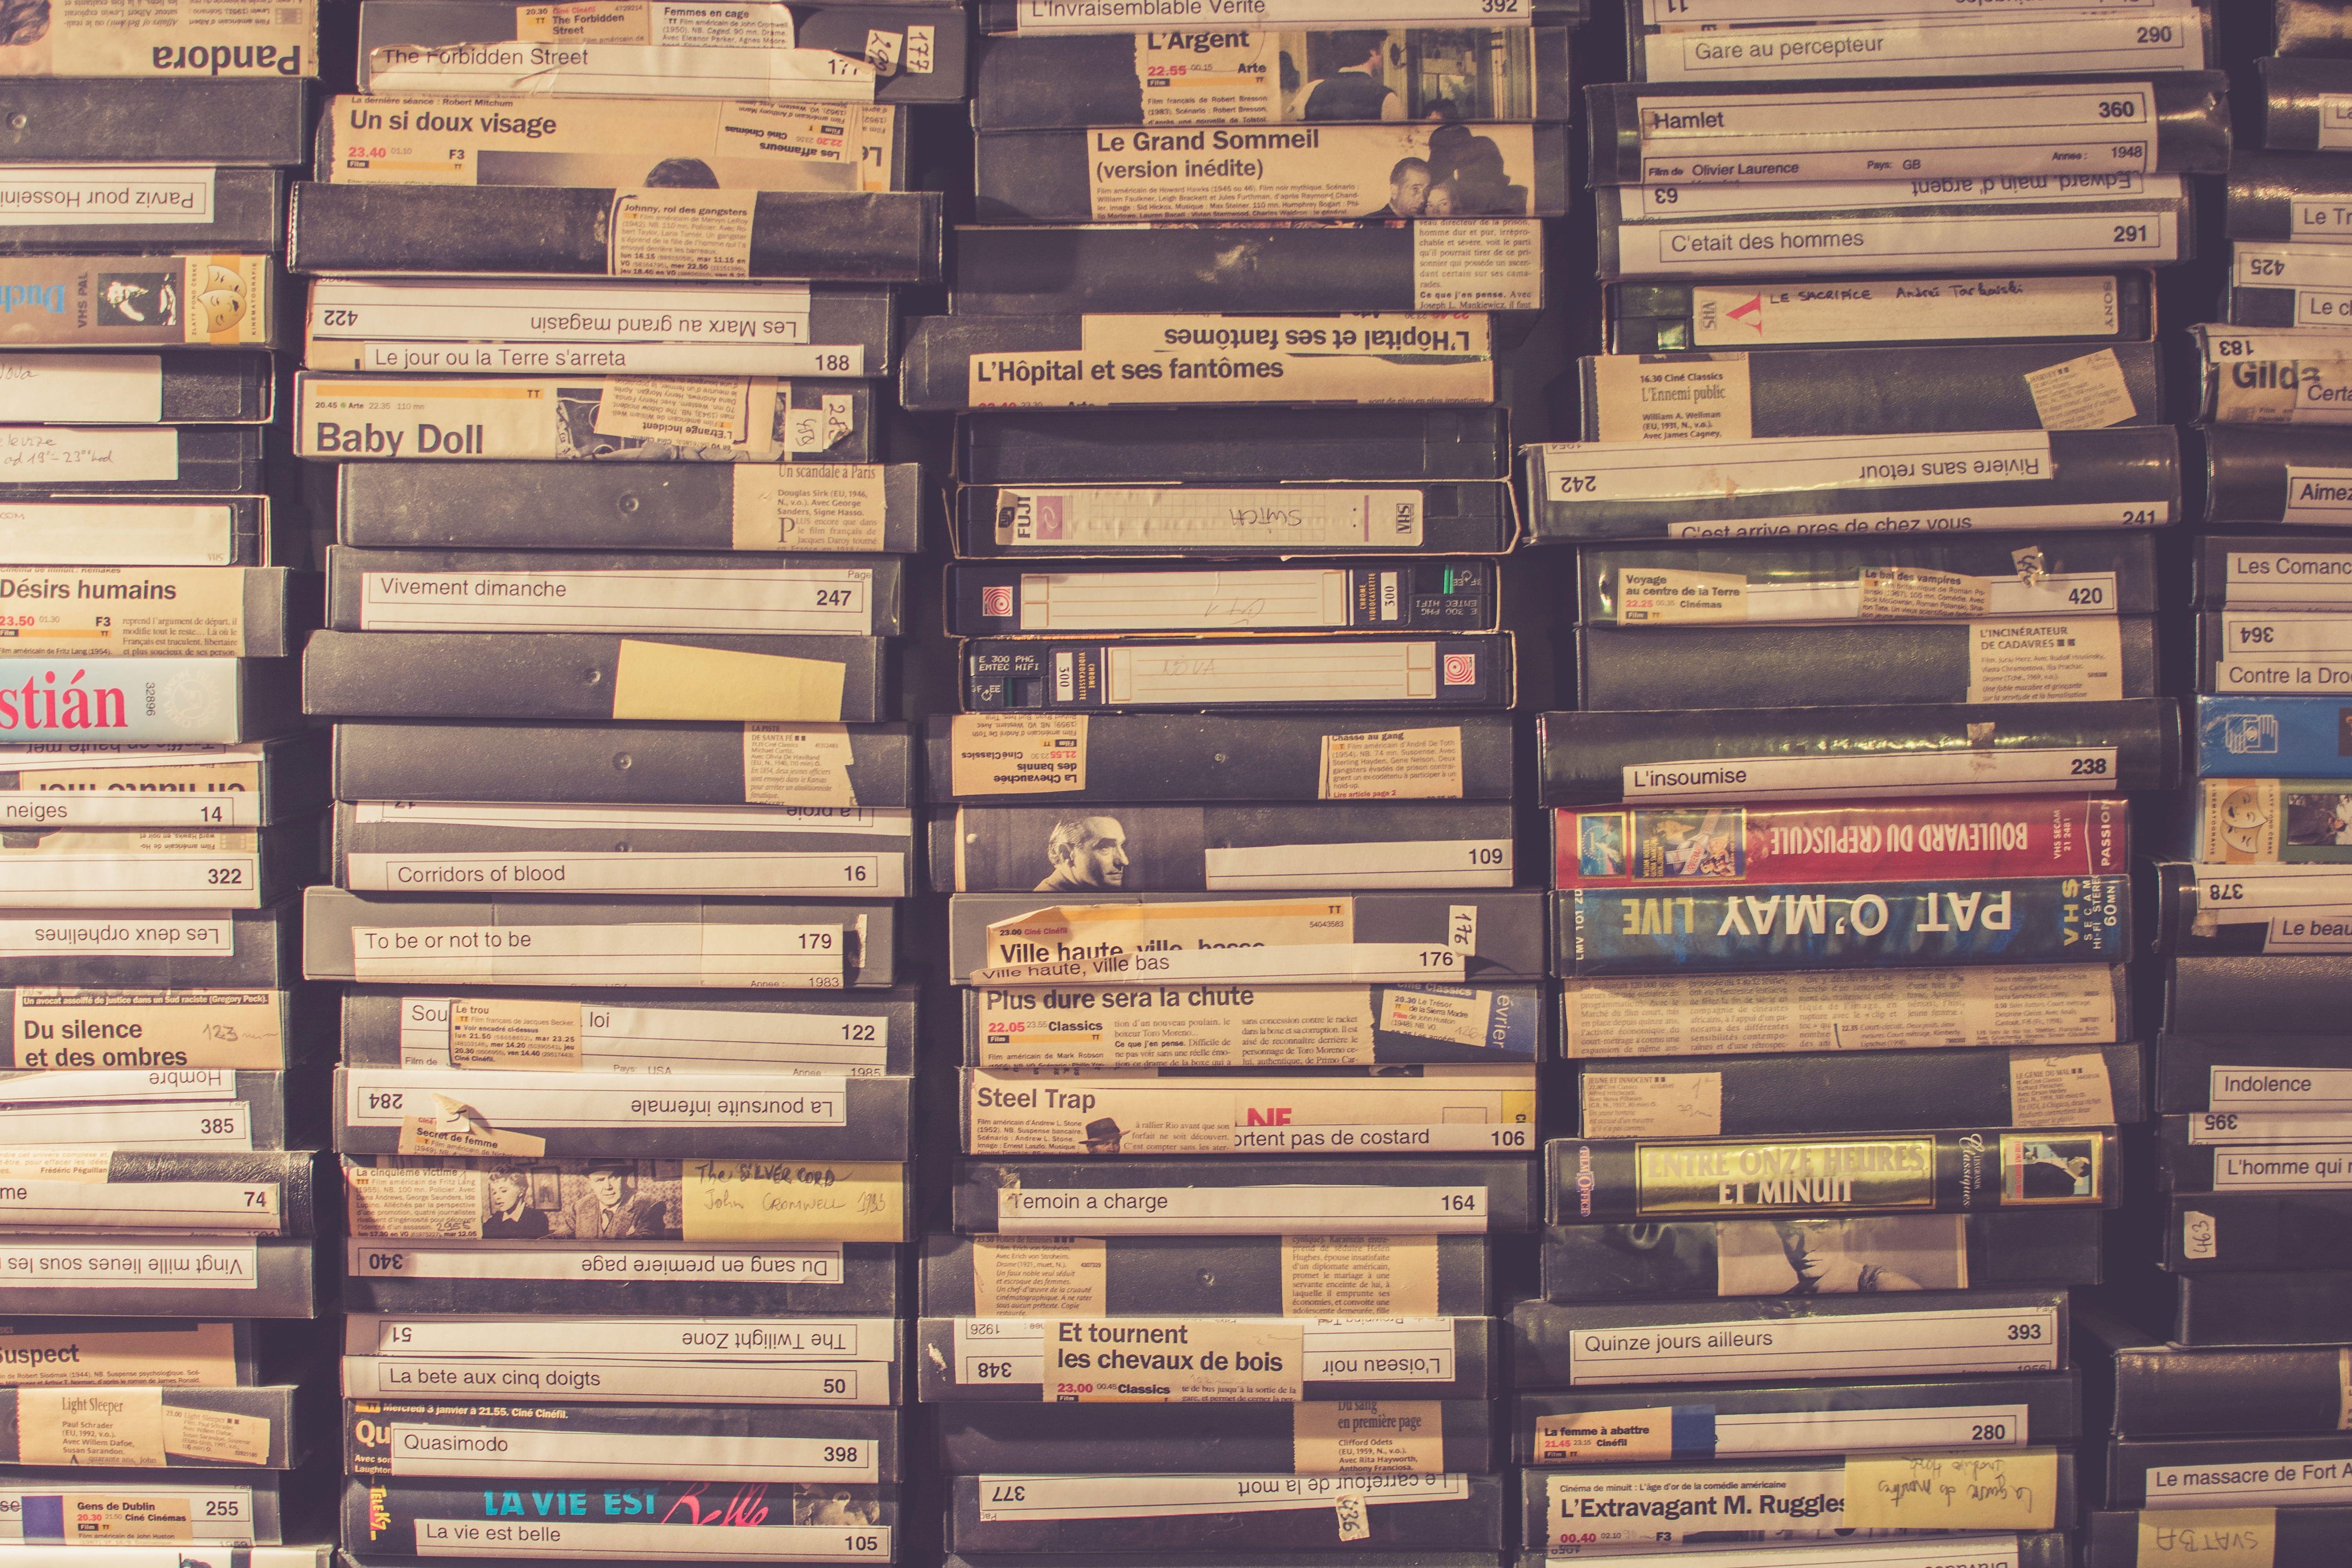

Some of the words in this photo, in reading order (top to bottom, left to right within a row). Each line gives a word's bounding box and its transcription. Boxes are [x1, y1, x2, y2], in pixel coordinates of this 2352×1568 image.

[664, 7, 706, 16] Femmes
[725, 11, 749, 20] cage
[2137, 26, 2172, 43] 290
[1695, 43, 1742, 60] Gare
[1749, 44, 1773, 57] au
[1780, 38, 1884, 60] percepteur
[152, 45, 300, 75] Pandora
[2099, 101, 2134, 118] 360
[351, 110, 381, 129] Un
[389, 111, 408, 130] si
[416, 112, 473, 131] doux
[481, 113, 556, 138] visage
[1654, 111, 1724, 129] Hamlet
[1098, 133, 1124, 151] Le
[1133, 131, 1204, 151] Grand
[1213, 129, 1318, 149] Sommeil
[449, 149, 465, 159] F3
[2112, 146, 2142, 158] 1948
[1097, 160, 1177, 183] (version
[1186, 159, 1263, 180] inédite)
[1692, 164, 1735, 176] Olivier
[1738, 164, 1799, 174] Laurence
[0, 190, 80, 207] Hosseini
[87, 188, 129, 204] pour
[136, 192, 193, 208] Parviz
[2114, 225, 2146, 242] 291
[1672, 235, 1733, 252] C'etait
[1739, 234, 1774, 250] des
[1781, 232, 1864, 248] hommes
[2251, 259, 2285, 276] 425
[325, 310, 358, 326] 422
[2219, 340, 2254, 356] 183
[376, 349, 397, 365] Le
[405, 349, 439, 369] jour
[446, 353, 468, 365] ou
[477, 349, 492, 365] la
[499, 349, 548, 365] Terre
[556, 350, 626, 366] s'arreta
[816, 355, 849, 371] 188
[978, 360, 1082, 386] L'Hôpital
[1091, 361, 1115, 380] et
[1122, 364, 1162, 379] ses
[1169, 357, 1283, 379] fantômes
[318, 422, 404, 457] Baby
[419, 424, 483, 454] Doll
[1017, 494, 1031, 538] FUJI
[381, 578, 468, 595] Vivement
[475, 580, 566, 597] dimanche
[1626, 575, 1667, 586] Voyage
[0, 579, 70, 599] Désirs
[78, 580, 176, 599] humains
[1643, 587, 1678, 595] centre
[1682, 587, 1695, 595] de
[1712, 587, 1740, 596] Terre
[2069, 588, 2102, 604] 420
[817, 590, 851, 606] 247
[2240, 627, 2274, 643] 364
[1981, 641, 1994, 650] DE
[1998, 639, 2054, 649] CADAVRES
[146, 683, 156, 716] 32896
[1017, 763, 1054, 772] bannis
[1057, 763, 1077, 771] des
[2071, 759, 2106, 775] 238
[994, 775, 1061, 784] Chevauchée
[1065, 775, 1077, 783] La
[1635, 768, 1746, 787] L'insoumise
[7, 802, 67, 822] neiges
[201, 807, 222, 822] 14
[1887, 824, 1912, 853] DU
[1918, 822, 2027, 851] BOULEVARD
[1469, 848, 1503, 864] 109
[209, 869, 241, 884] 322
[398, 867, 484, 882] Corridors
[490, 866, 507, 881] of
[515, 865, 564, 881] blood
[845, 866, 866, 881] 16
[2210, 884, 2243, 900] 378
[1621, 897, 1694, 935] LIVE
[1717, 895, 1887, 936] O'MAY
[1917, 891, 2011, 931] PAT
[35, 924, 130, 944] orphelines
[136, 929, 180, 944] deux
[187, 929, 218, 944] Les
[799, 934, 831, 949] 179
[1420, 952, 1453, 966] 176
[987, 989, 1036, 1010] Plus
[1043, 989, 1095, 1010] dure
[1102, 989, 1151, 1009] sera
[1160, 987, 1180, 1007] la
[1188, 985, 1254, 1007] chute
[25, 1021, 53, 1039] Du
[62, 1020, 142, 1039] silence
[26, 1049, 48, 1067] et
[56, 1048, 95, 1067] des
[103, 1047, 187, 1066] ombres
[2225, 1076, 2311, 1091] Indolence
[369, 1094, 402, 1109] 284
[632, 1100, 710, 1116] infernale
[718, 1097, 803, 1116] poursuite
[978, 1087, 1036, 1107] Steel
[1045, 1088, 1096, 1113] Trap
[811, 1102, 832, 1117] La
[201, 1118, 233, 1134] 385
[2205, 1114, 2238, 1130] 395
[1492, 1131, 1524, 1146] 106
[2228, 1160, 2309, 1175] L'homme
[2316, 1158, 2342, 1178] qui
[1007, 1193, 1079, 1209] Temoin
[1087, 1197, 1097, 1209] a
[1104, 1193, 1167, 1213] charge
[1442, 1195, 1475, 1210] 164
[8, 1258, 33, 1273] les
[40, 1258, 82, 1270] sous
[89, 1258, 141, 1274] lieues
[149, 1259, 189, 1274] mille
[196, 1256, 243, 1275] Vingt
[1059, 1323, 1082, 1342] Et
[1089, 1324, 1187, 1344] tournent
[2008, 1324, 2041, 1340] 393
[1585, 1336, 1650, 1352] Quinze
[1656, 1334, 1701, 1353] jours
[1708, 1332, 1772, 1347] ailleurs
[1058, 1348, 1090, 1368] les
[1098, 1350, 1193, 1370] chevaux
[1200, 1351, 1228, 1370] de
[1236, 1352, 1282, 1371] bois
[978, 1363, 1011, 1377] 348
[1544, 1428, 1557, 1436] La
[1560, 1426, 1597, 1436] femme
[1601, 1426, 1607, 1435] à
[1610, 1426, 1649, 1435] abattre
[1972, 1425, 2005, 1440] 280
[405, 1434, 508, 1451] Quasimodo
[824, 1447, 857, 1462] 398
[2157, 1472, 2177, 1486] Le
[2184, 1470, 2269, 1485] massacre
[2275, 1466, 2296, 1481] de
[2303, 1464, 2336, 1479] Fort
[993, 1486, 1025, 1501] 377
[207, 1501, 238, 1516] 255
[845, 1536, 877, 1550] 105
